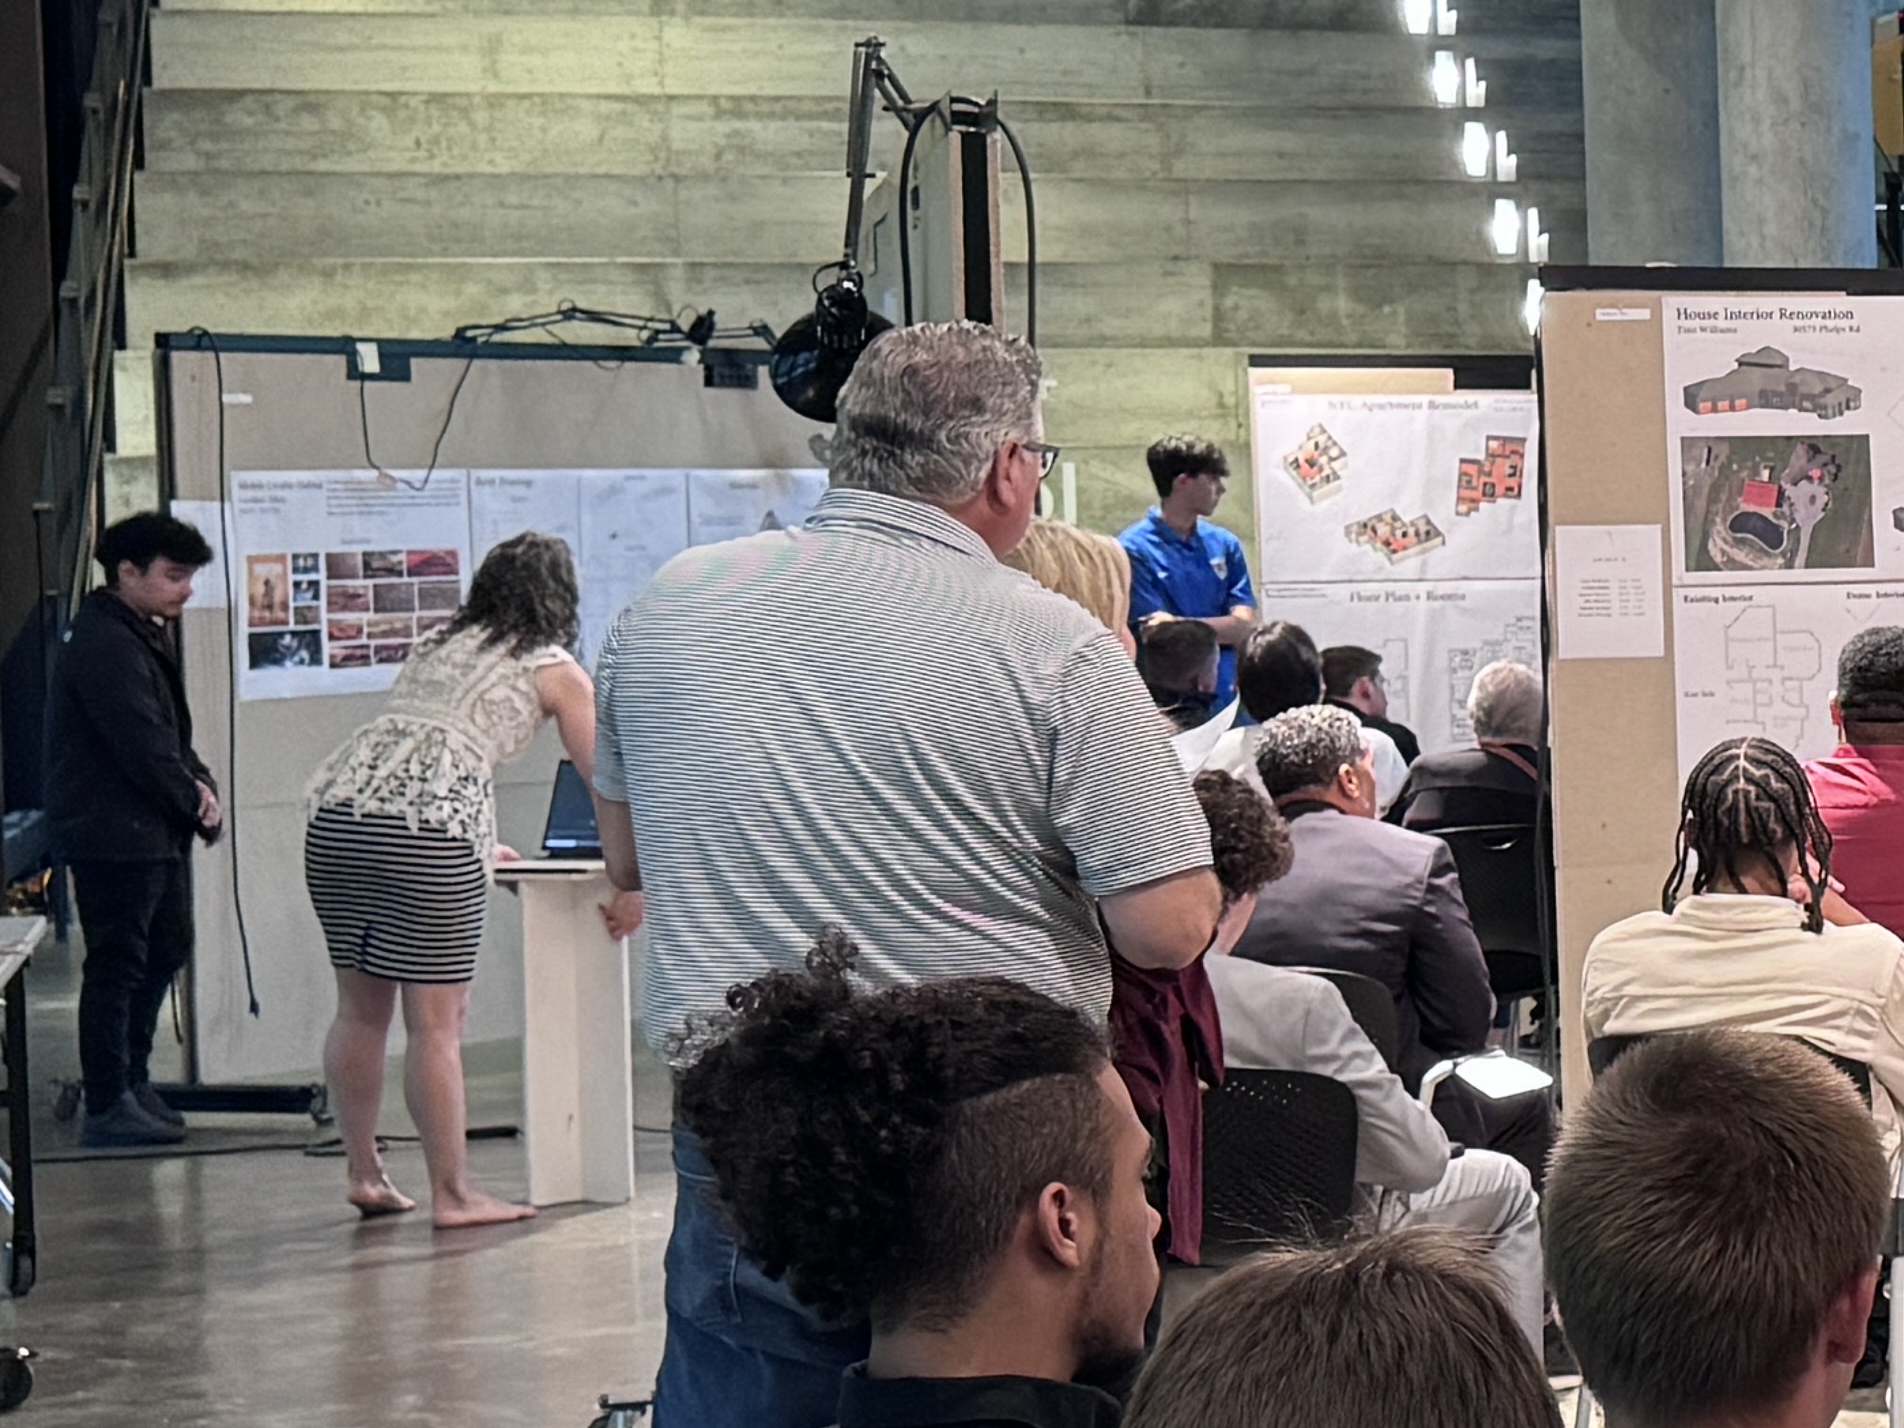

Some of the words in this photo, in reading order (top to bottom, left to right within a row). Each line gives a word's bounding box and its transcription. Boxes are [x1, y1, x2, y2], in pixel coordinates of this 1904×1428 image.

[1676, 308, 1720, 321] House
[1724, 308, 1774, 321] Interior
[1779, 307, 1854, 321] Renovation
